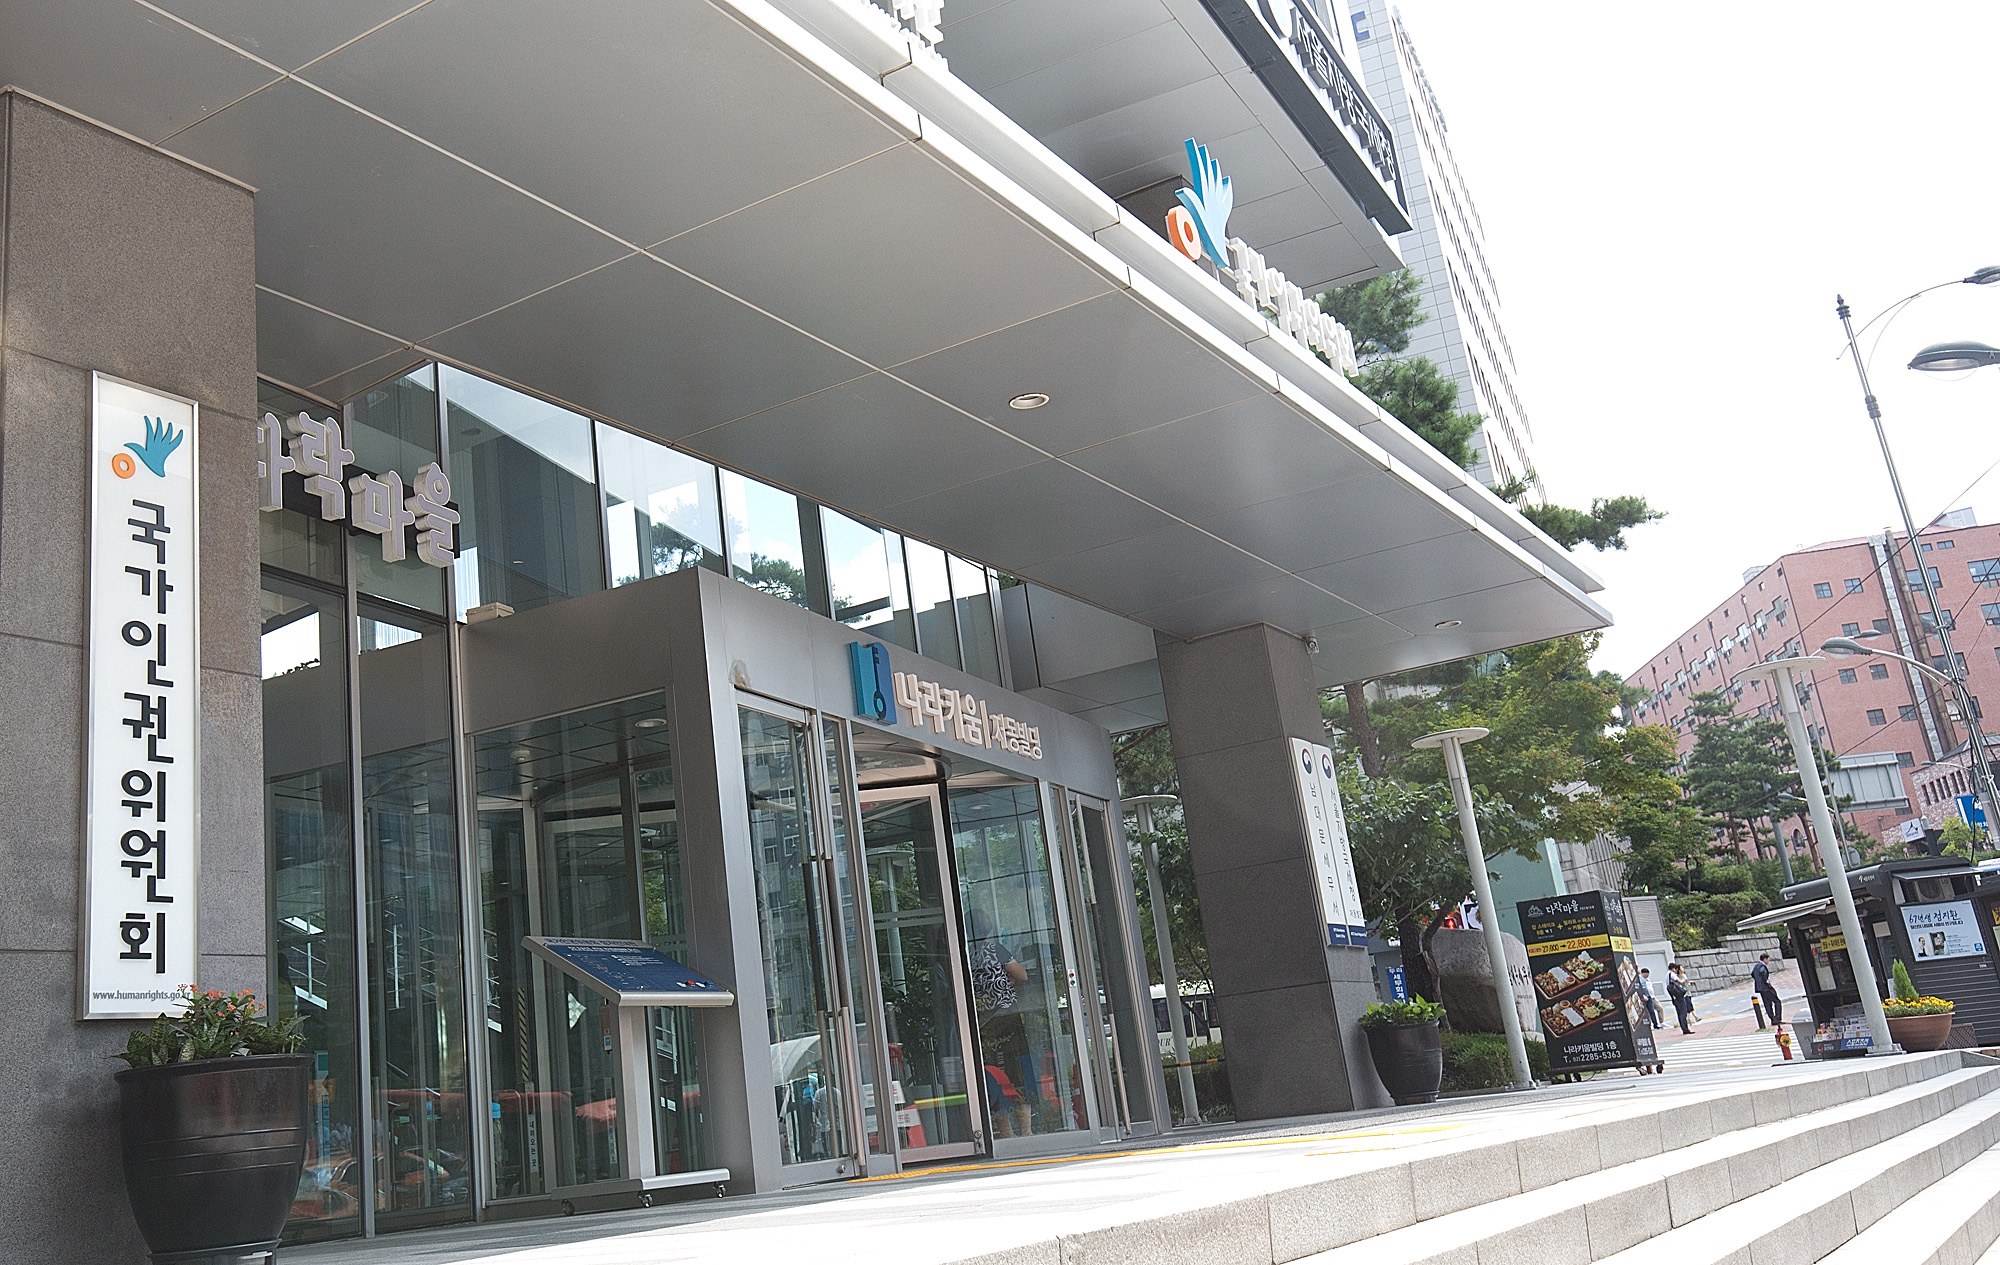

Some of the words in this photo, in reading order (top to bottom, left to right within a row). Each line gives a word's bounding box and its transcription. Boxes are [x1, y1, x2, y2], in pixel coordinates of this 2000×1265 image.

[894, 671, 983, 746] 나라키움
[989, 713, 1043, 761] 저동빌딩
[119, 499, 174, 975] 국가인권위원회
[1545, 899, 1579, 915] 다락마을
[1567, 938, 1591, 950] 22,800
[1563, 1042, 1604, 1054] 나라키움빌딩
[1605, 1040, 1617, 1050] 1층
